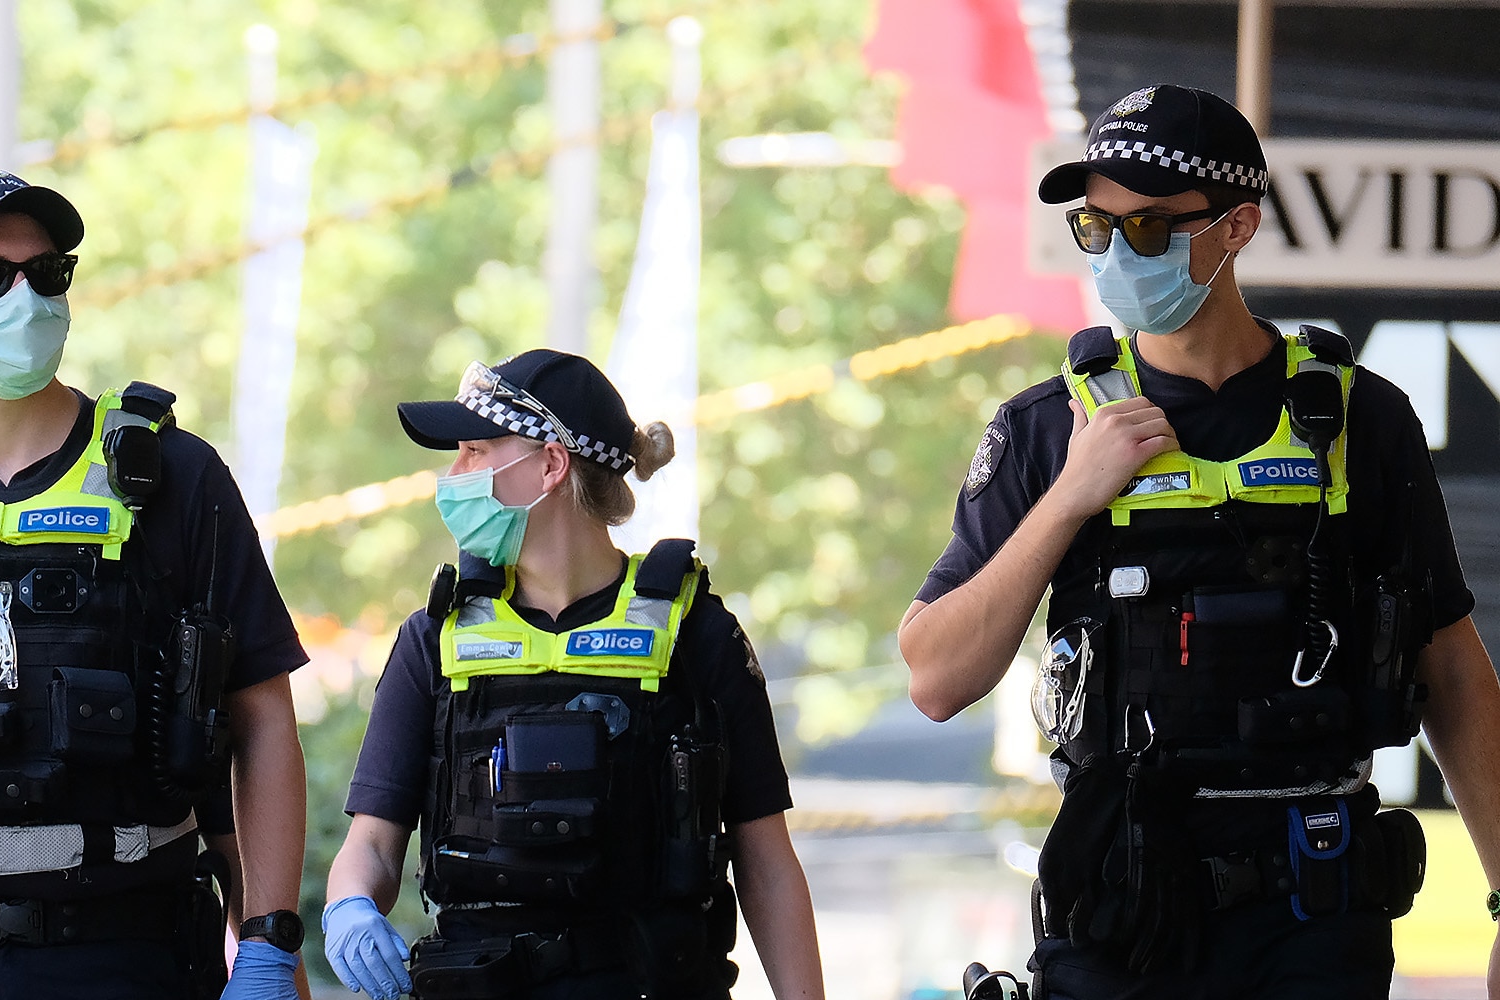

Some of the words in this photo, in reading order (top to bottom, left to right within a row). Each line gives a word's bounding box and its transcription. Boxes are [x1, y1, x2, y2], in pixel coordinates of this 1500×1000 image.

[1122, 121, 1149, 133] POLICE
[1248, 462, 1319, 480] Police
[27, 511, 99, 526] Police
[460, 644, 485, 653] Emma
[575, 633, 643, 650] Police
